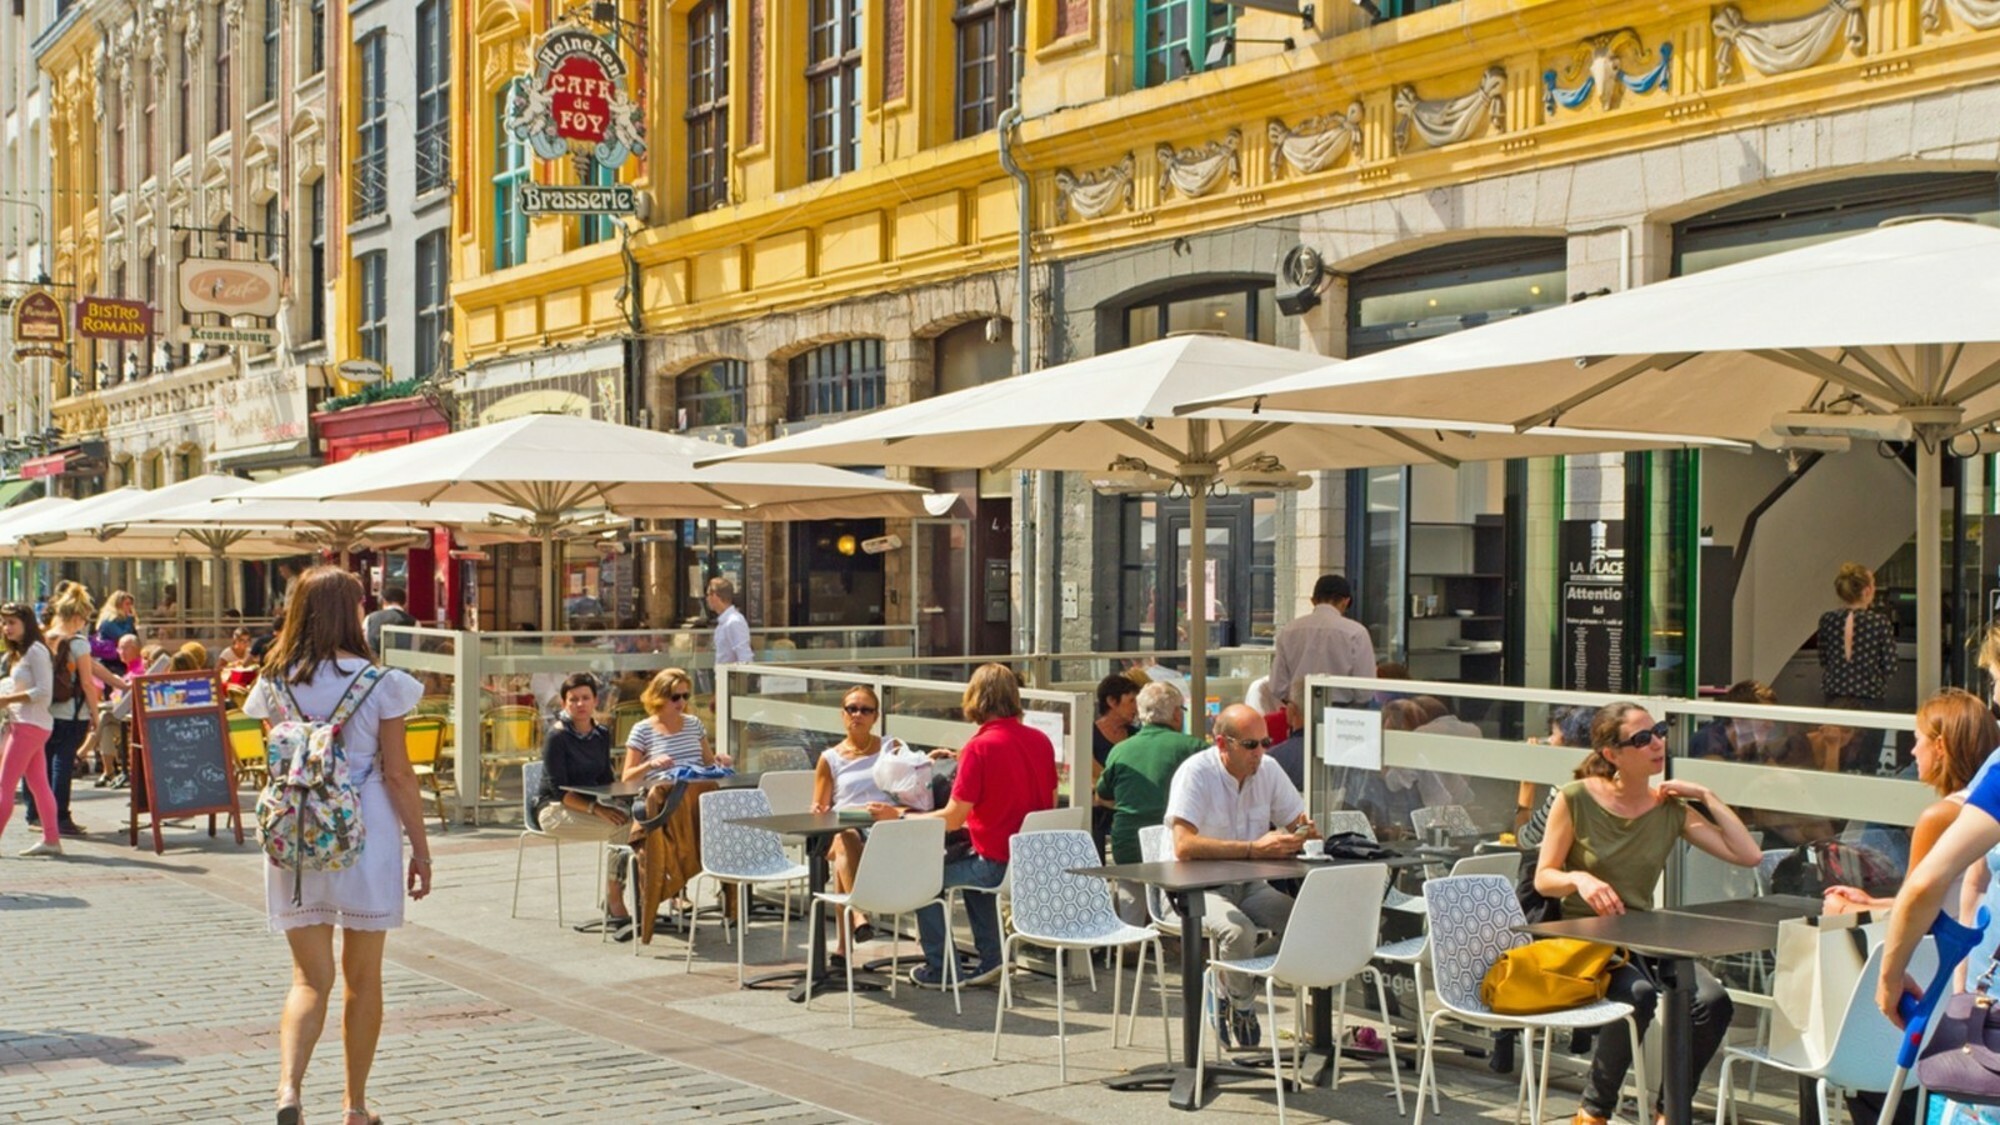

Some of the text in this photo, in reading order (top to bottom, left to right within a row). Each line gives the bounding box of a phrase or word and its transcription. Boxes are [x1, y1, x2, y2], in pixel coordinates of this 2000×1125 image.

[540, 35, 621, 77] Heineken
[573, 98, 590, 110] de
[559, 110, 604, 134] FOY
[524, 188, 630, 211] Brasserie
[88, 303, 139, 319] BISTRO
[82, 316, 145, 334] ROMAIN
[190, 327, 271, 345] Kronenbourg
[1569, 561, 1624, 574] LA PLACE
[1567, 586, 1622, 601] Attentio
